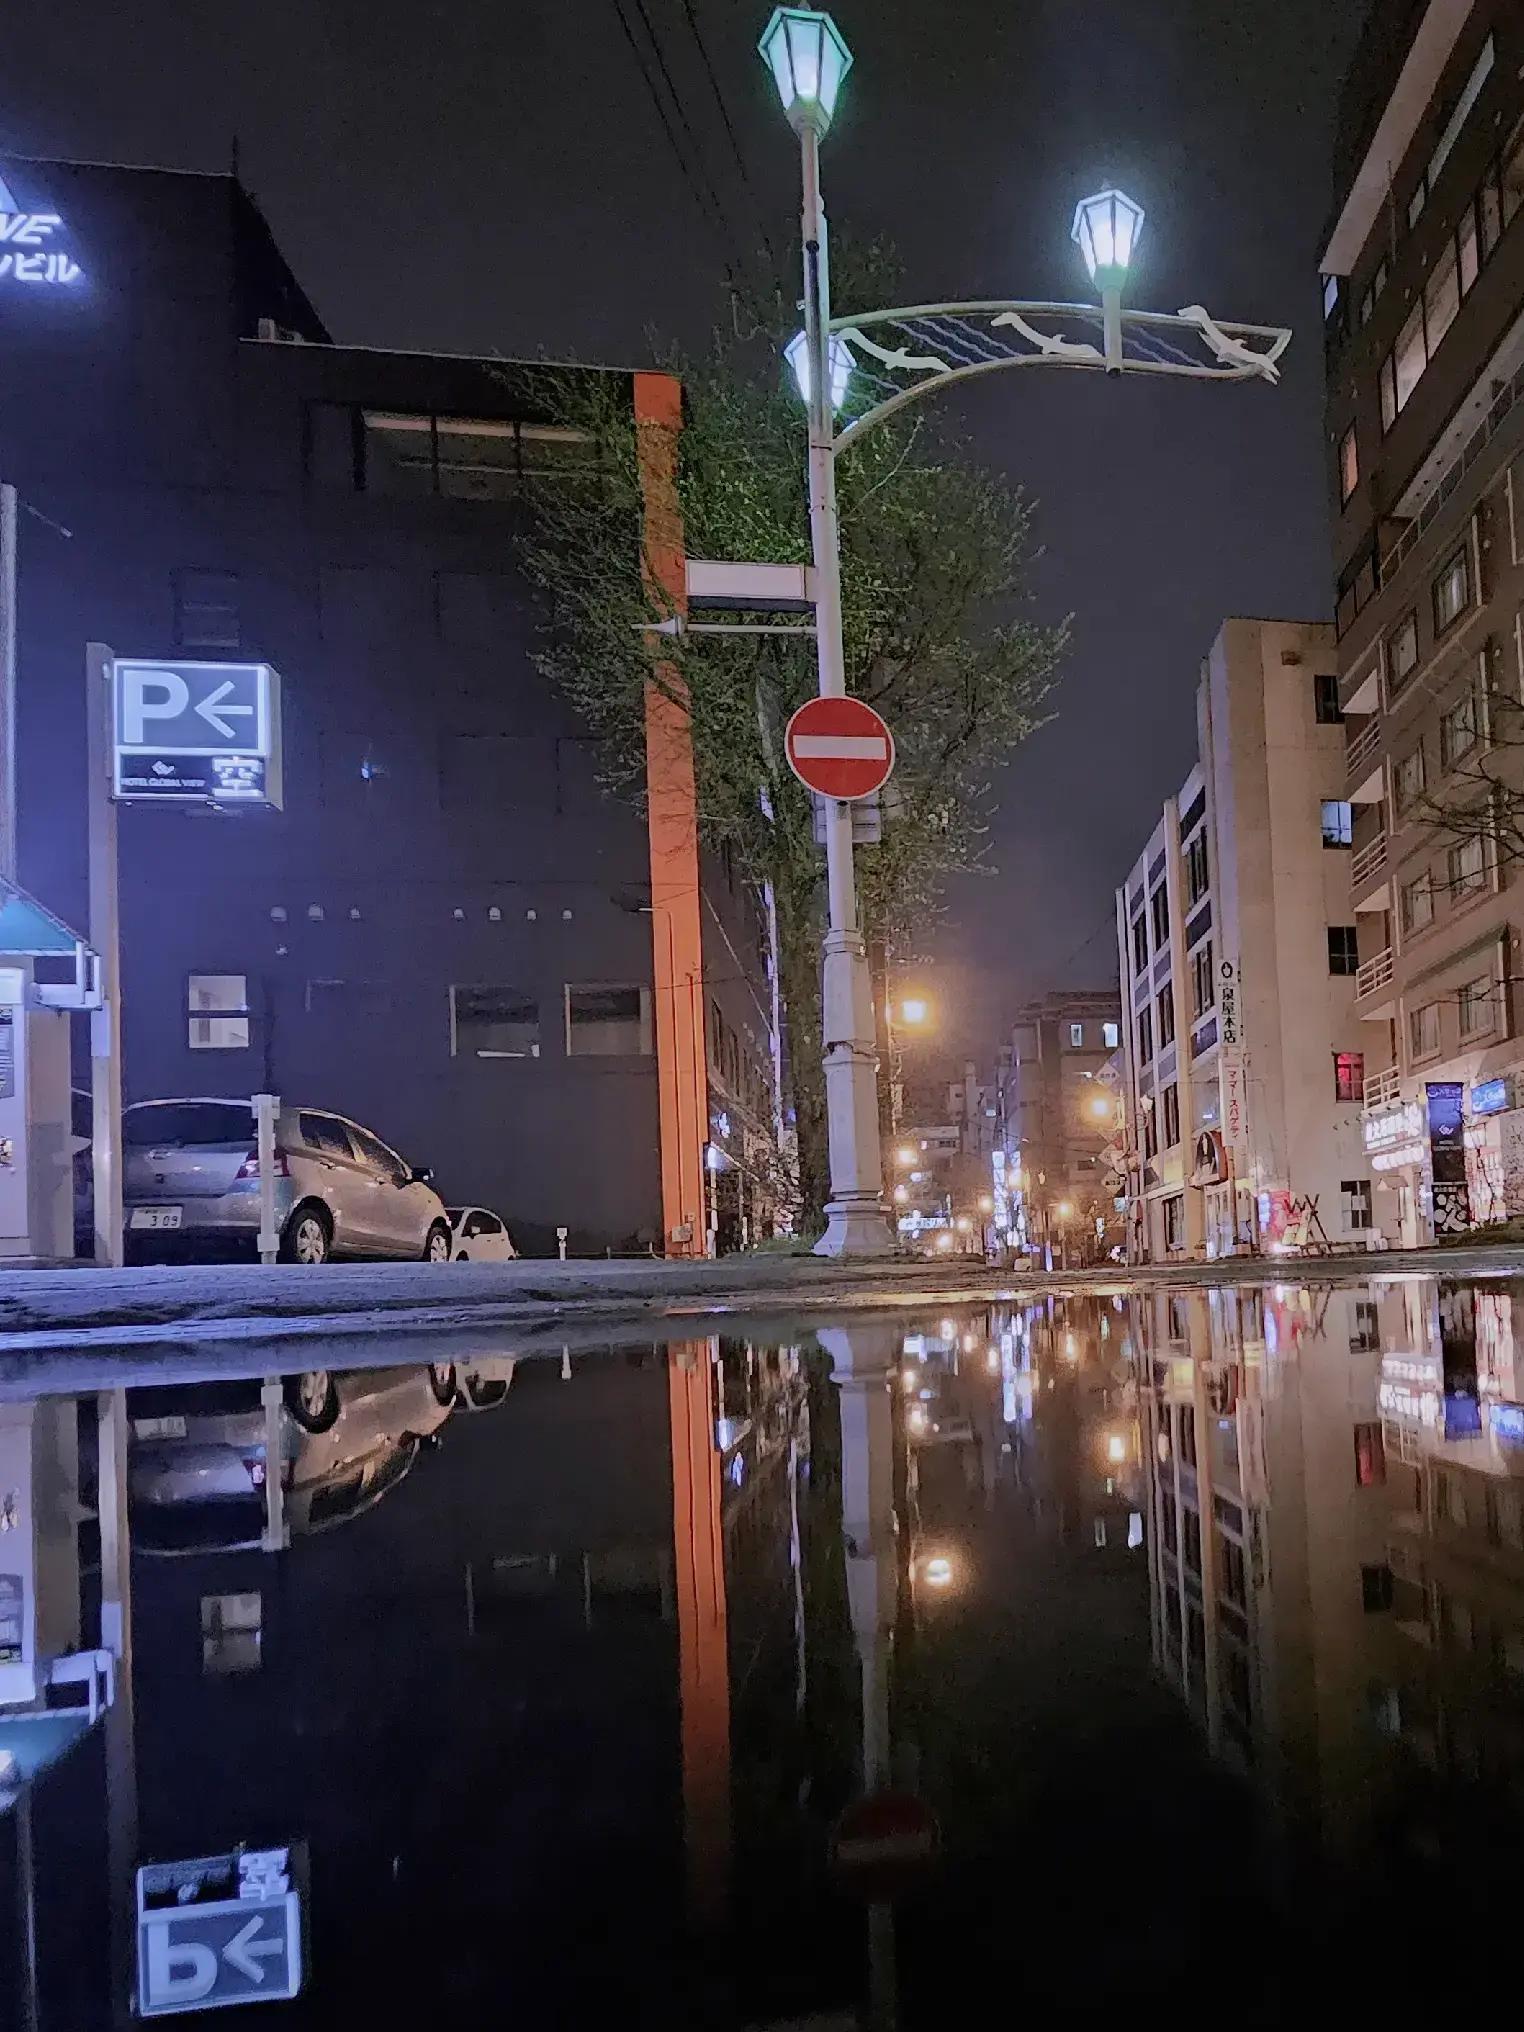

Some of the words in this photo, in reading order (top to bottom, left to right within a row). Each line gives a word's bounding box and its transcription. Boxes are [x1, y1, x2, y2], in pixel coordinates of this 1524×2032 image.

[123, 669, 190, 743] P
[212, 756, 264, 798] 空
[1221, 987, 1237, 1044] 泉屋本店
